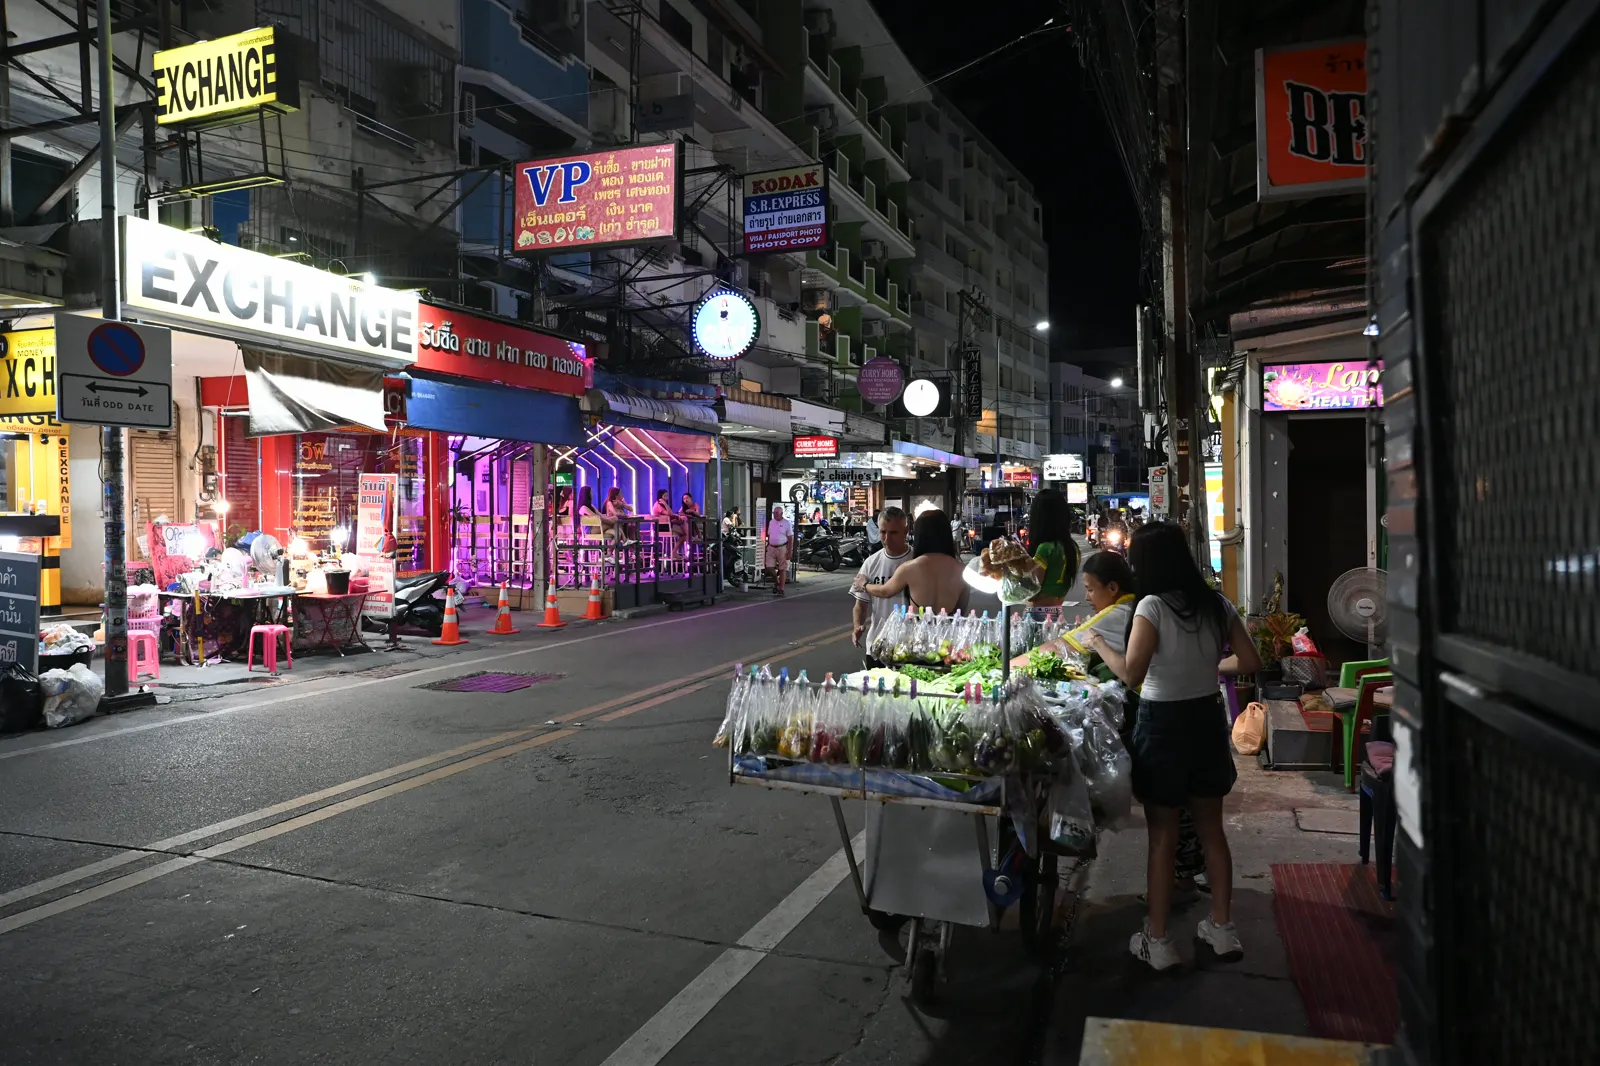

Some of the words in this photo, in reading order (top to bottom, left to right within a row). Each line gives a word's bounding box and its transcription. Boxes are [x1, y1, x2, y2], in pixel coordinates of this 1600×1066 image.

[153, 44, 278, 116] EXCHANGE
[593, 154, 620, 175] รับซื้อ
[631, 155, 671, 171] ขายฝาก
[523, 160, 592, 207] VP
[601, 175, 624, 187] ทอง
[752, 172, 819, 194] KODAK
[594, 189, 621, 201] เพชร
[626, 184, 671, 198] เศษทอง
[605, 202, 625, 217] เงิน
[750, 192, 820, 213] S.R.EXPRESS
[520, 205, 587, 228] เซ็นเตอร์
[749, 214, 775, 230] ถ่ายรูป
[778, 211, 822, 226] ถ่ายเอกสาร
[750, 240, 787, 250] PHOTO
[790, 236, 820, 245] COPY
[768, 230, 798, 240] PASSPORT
[800, 227, 822, 236] PHOTO
[142, 249, 413, 353] EXCHANGE
[420, 320, 459, 352] รับซื้อ
[464, 337, 491, 357] ขาย
[496, 340, 520, 364] ฝาก
[17, 349, 44, 357] MONEY
[862, 368, 881, 378] CURRY
[881, 368, 898, 378] HOME
[103, 400, 123, 409] ODD
[128, 403, 154, 412] DATE
[796, 440, 817, 448] CURRY
[60, 450, 70, 524] EXCHANGE
